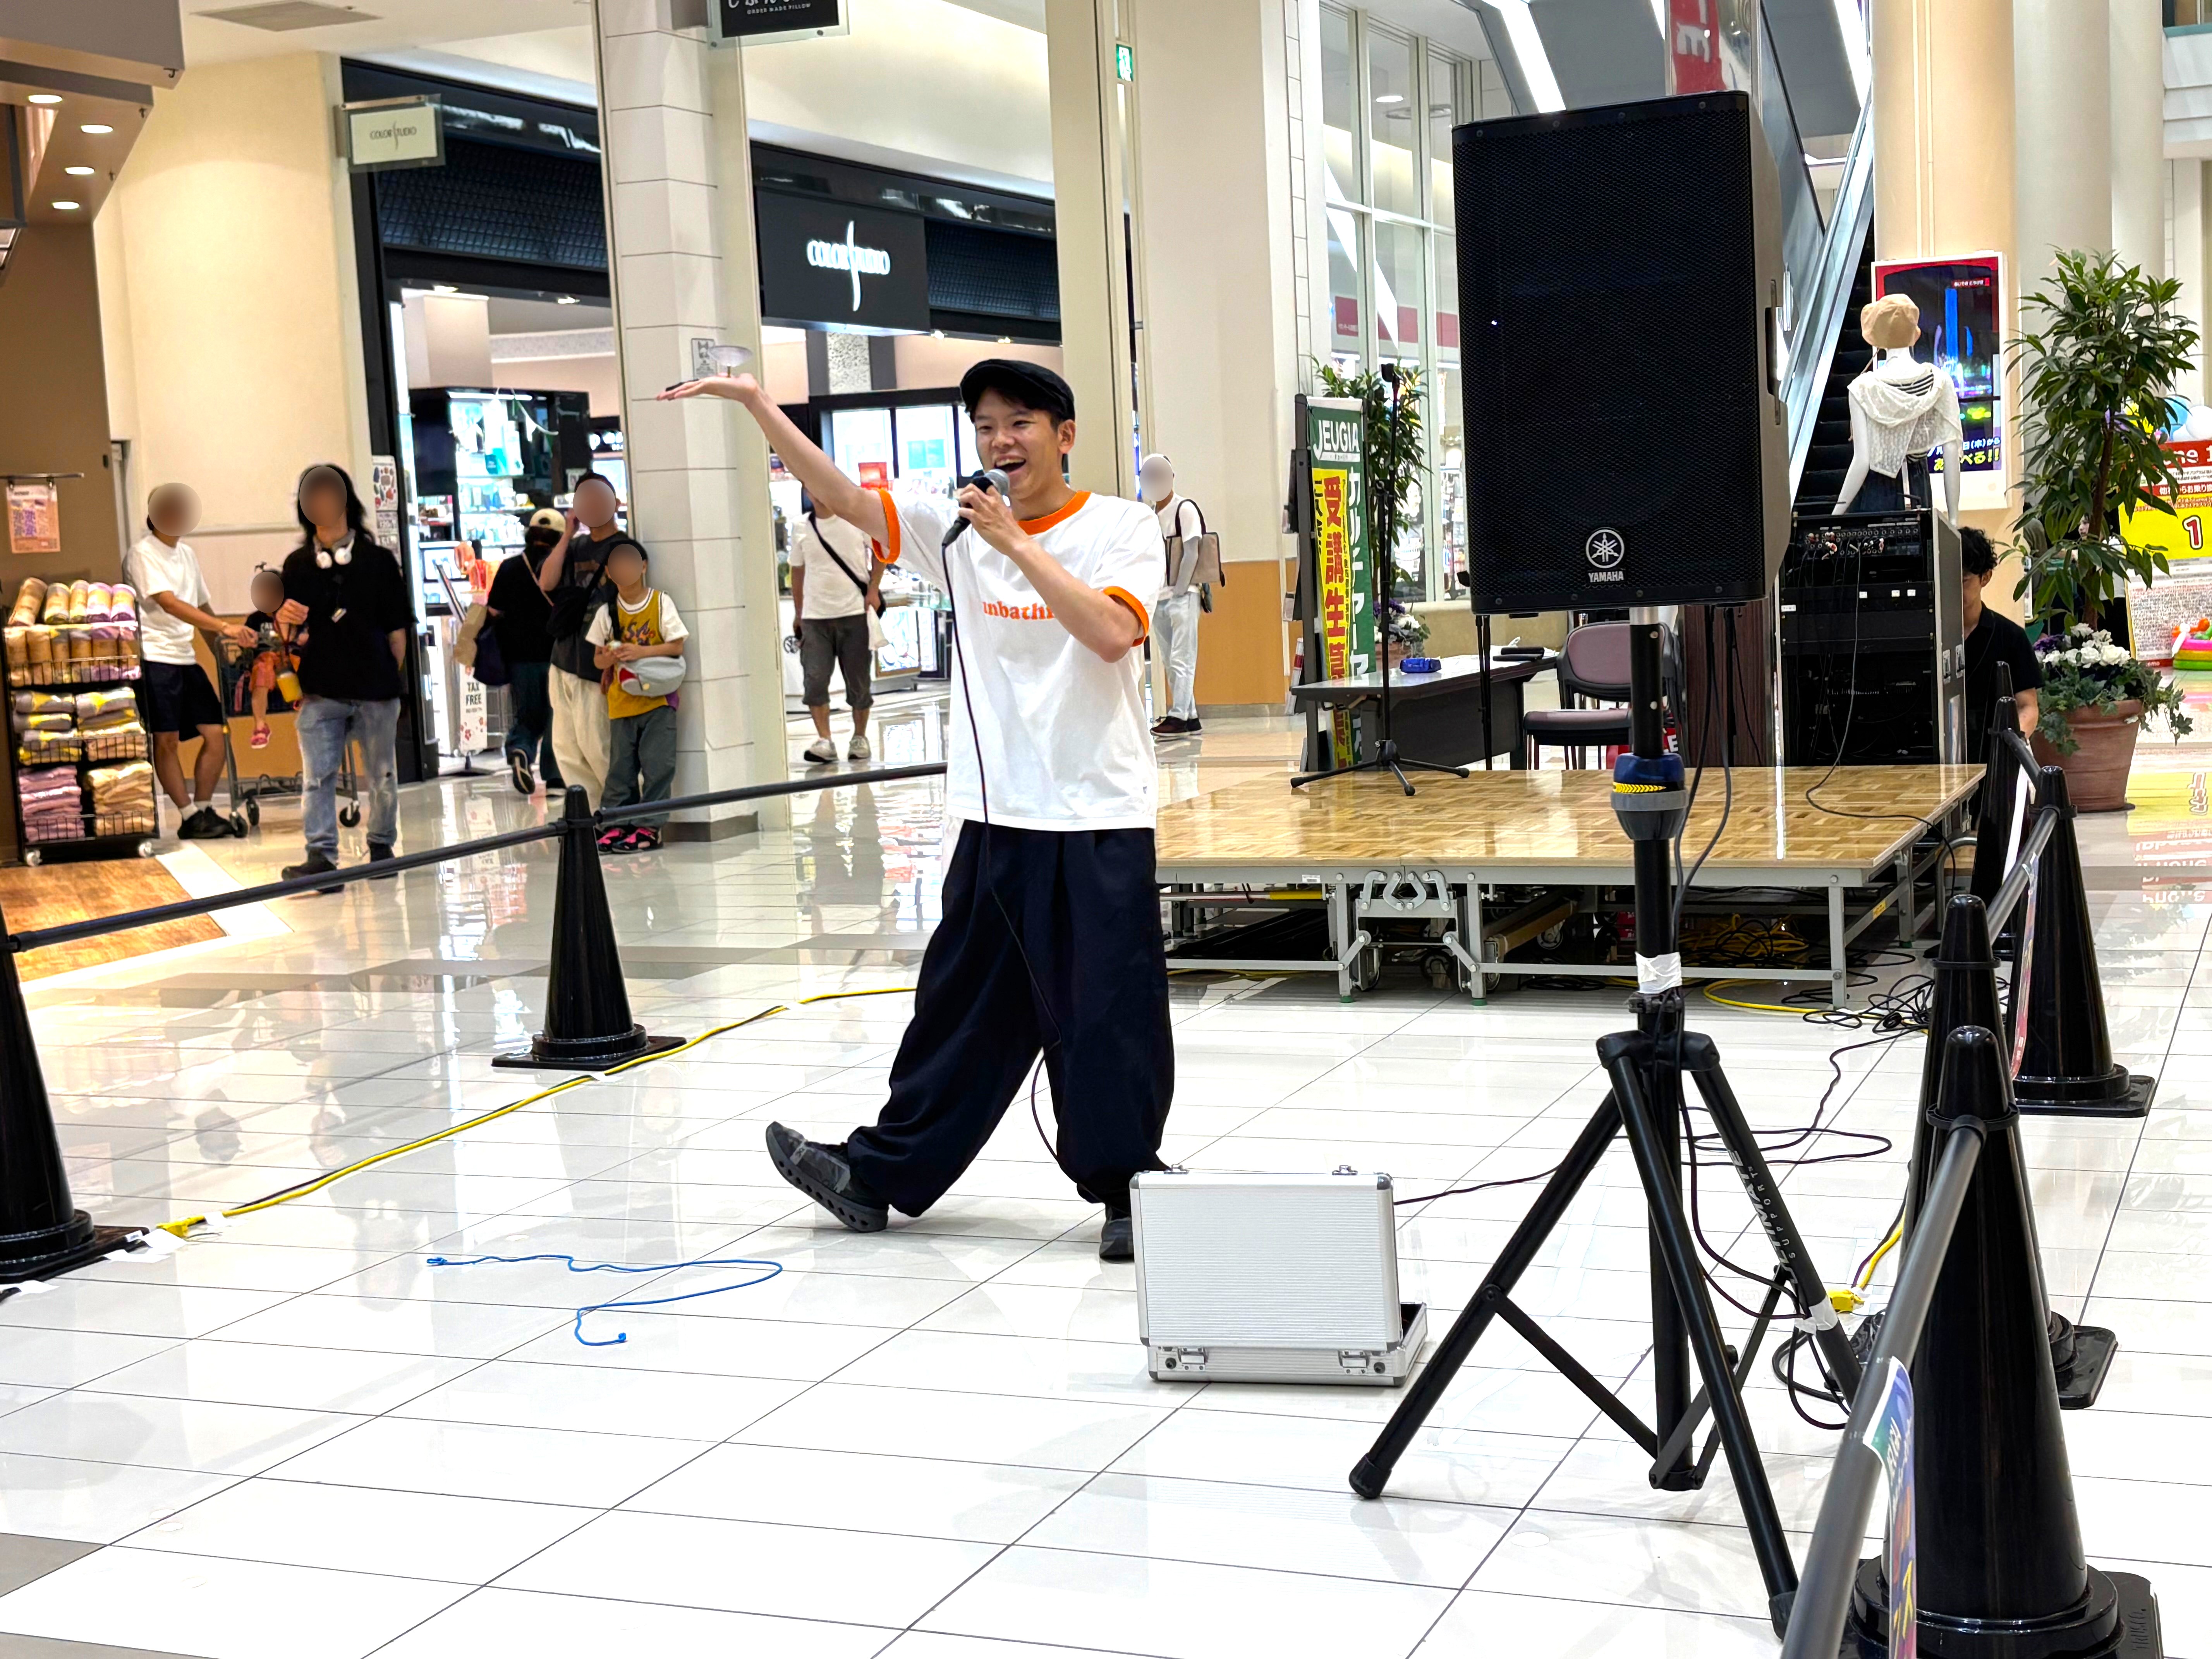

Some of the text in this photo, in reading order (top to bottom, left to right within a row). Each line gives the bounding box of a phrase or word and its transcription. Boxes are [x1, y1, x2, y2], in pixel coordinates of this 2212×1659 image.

[1313, 419, 1360, 460] JEUGIA
[1934, 447, 2000, 471] あべる!!
[1588, 571, 1624, 583] YAMAHA
[467, 682, 480, 692] TAX
[466, 693, 482, 706] FREE
[1728, 1149, 1798, 1284] ULTIMATE
